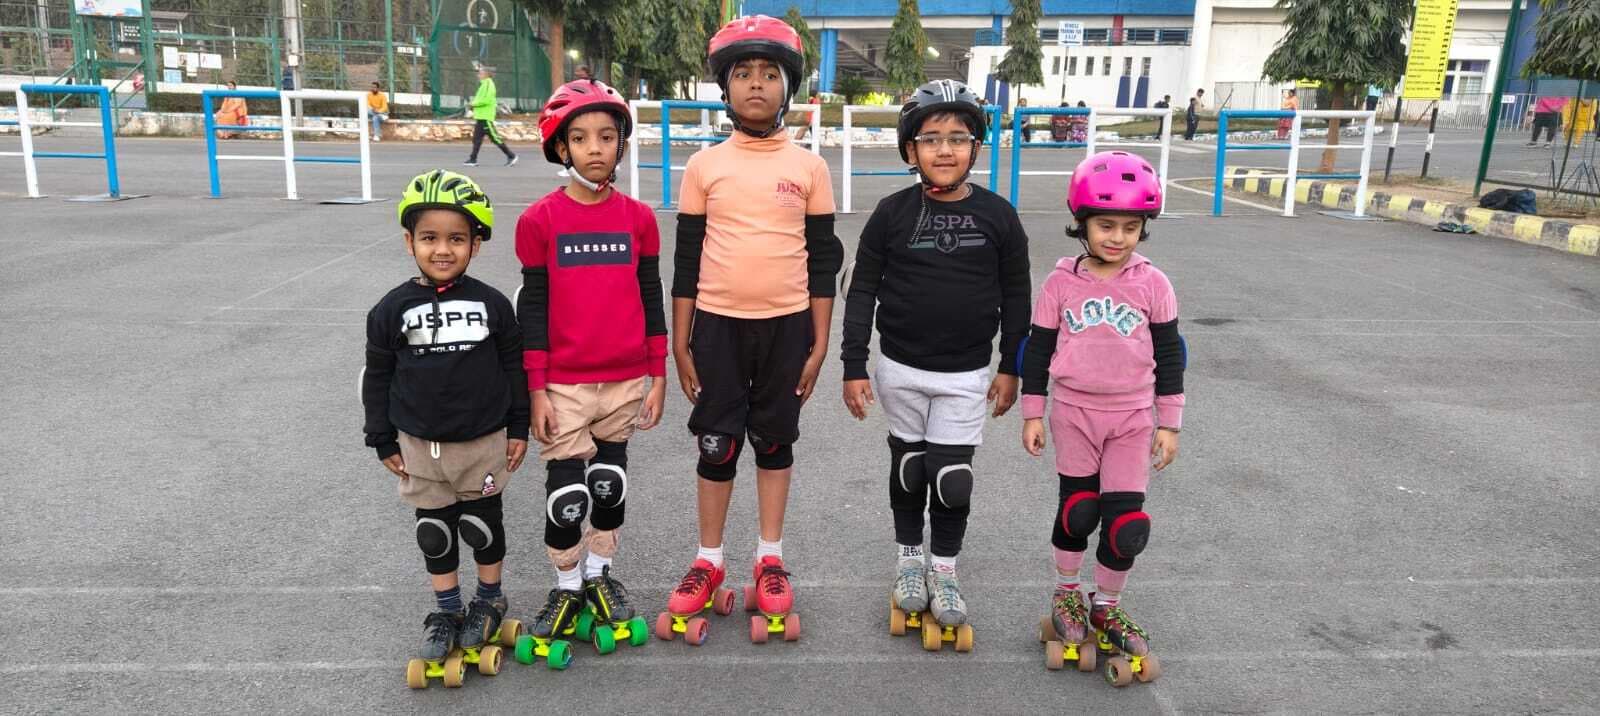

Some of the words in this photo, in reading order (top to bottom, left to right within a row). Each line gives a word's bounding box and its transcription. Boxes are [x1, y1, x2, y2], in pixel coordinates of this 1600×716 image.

[564, 243, 627, 254] BLESSED
[1064, 295, 1145, 337] LOVE
[594, 480, 612, 491] CS
